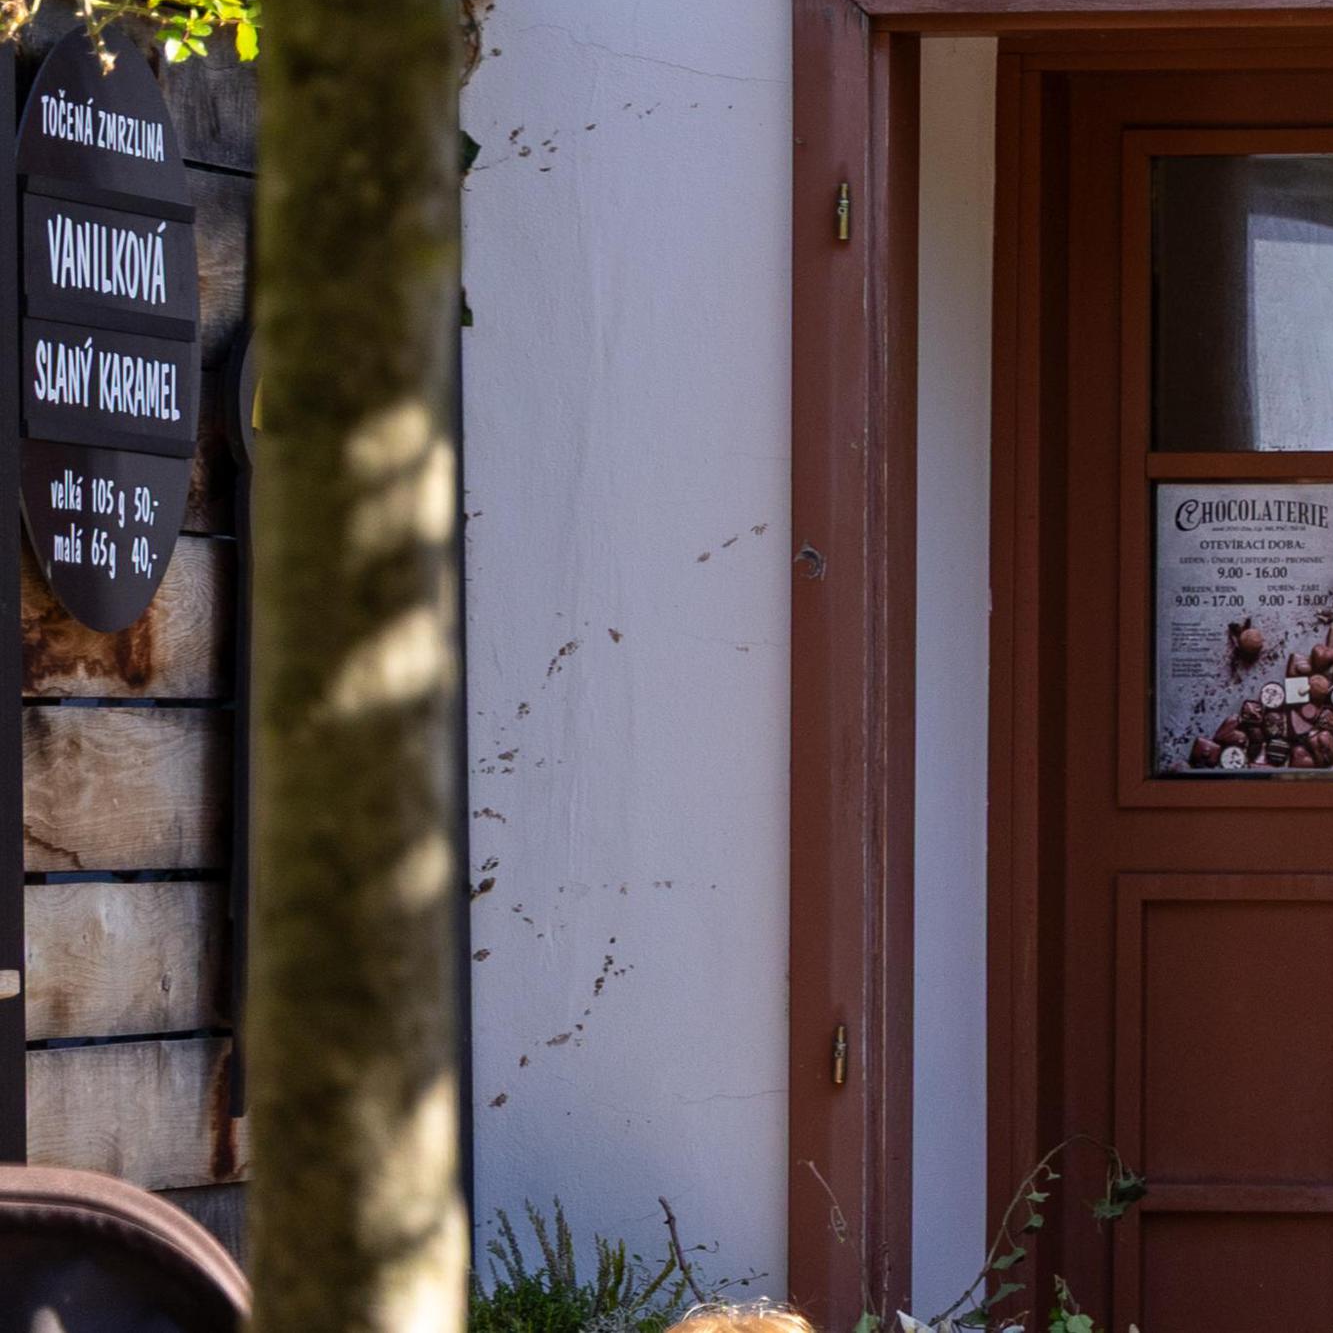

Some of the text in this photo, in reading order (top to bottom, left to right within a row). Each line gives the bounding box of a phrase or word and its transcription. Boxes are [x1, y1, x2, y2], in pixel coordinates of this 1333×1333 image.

[41, 89, 165, 164] TOČENÁ ZMRZLINA
[47, 214, 167, 305] VANILKOVÁ
[34, 336, 181, 422] SLANÝ KARAMEL
[50, 469, 83, 513] velká
[91, 478, 114, 516] 105
[1174, 498, 1329, 532] CHOCOLATERIE
[54, 523, 83, 565] malá
[1217, 566, 1243, 579] 9.00
[1255, 566, 1288, 579] 16.00
[1175, 595, 1200, 608] 9.00
[1212, 595, 1245, 608] 17.00
[1258, 594, 1285, 607] 9.00
[1296, 594, 1329, 607] 18.00
